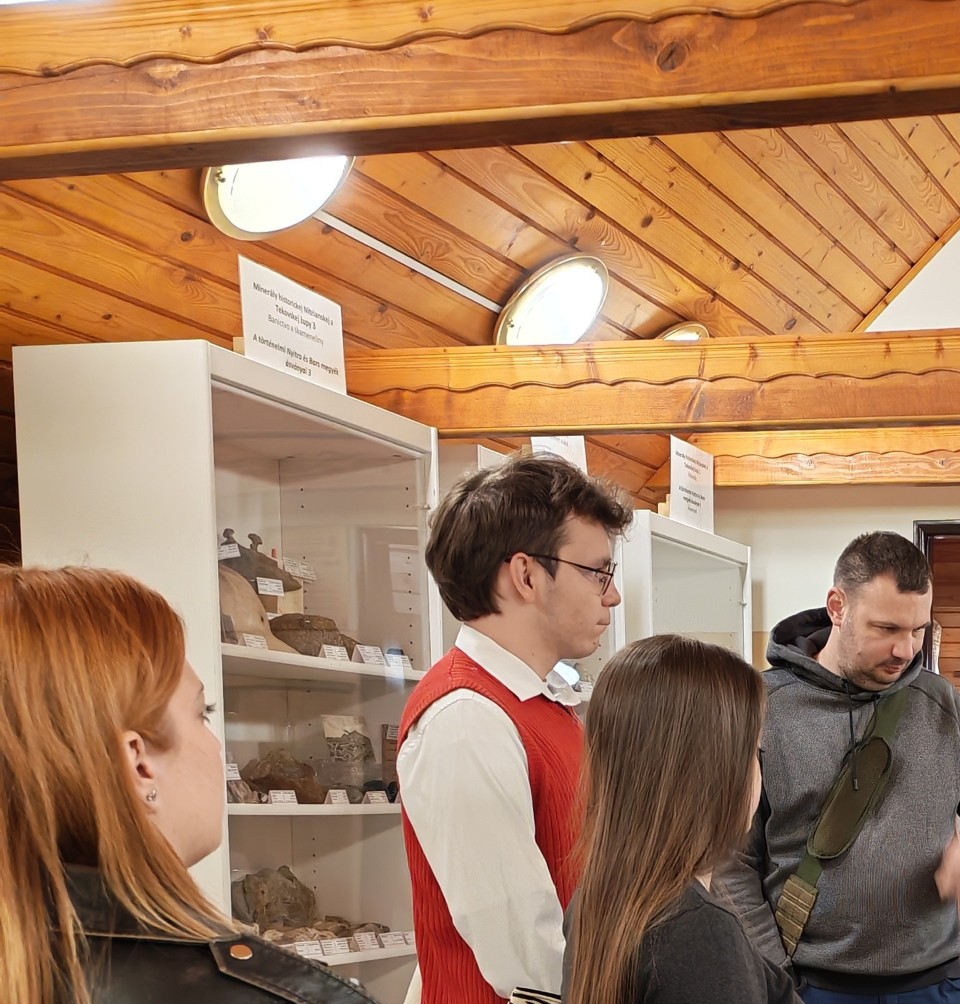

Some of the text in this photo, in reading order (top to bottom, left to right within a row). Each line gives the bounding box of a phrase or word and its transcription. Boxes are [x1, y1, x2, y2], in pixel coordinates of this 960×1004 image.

[312, 322, 316, 330] 3
[252, 333, 258, 342] A
[308, 368, 312, 376] 3
